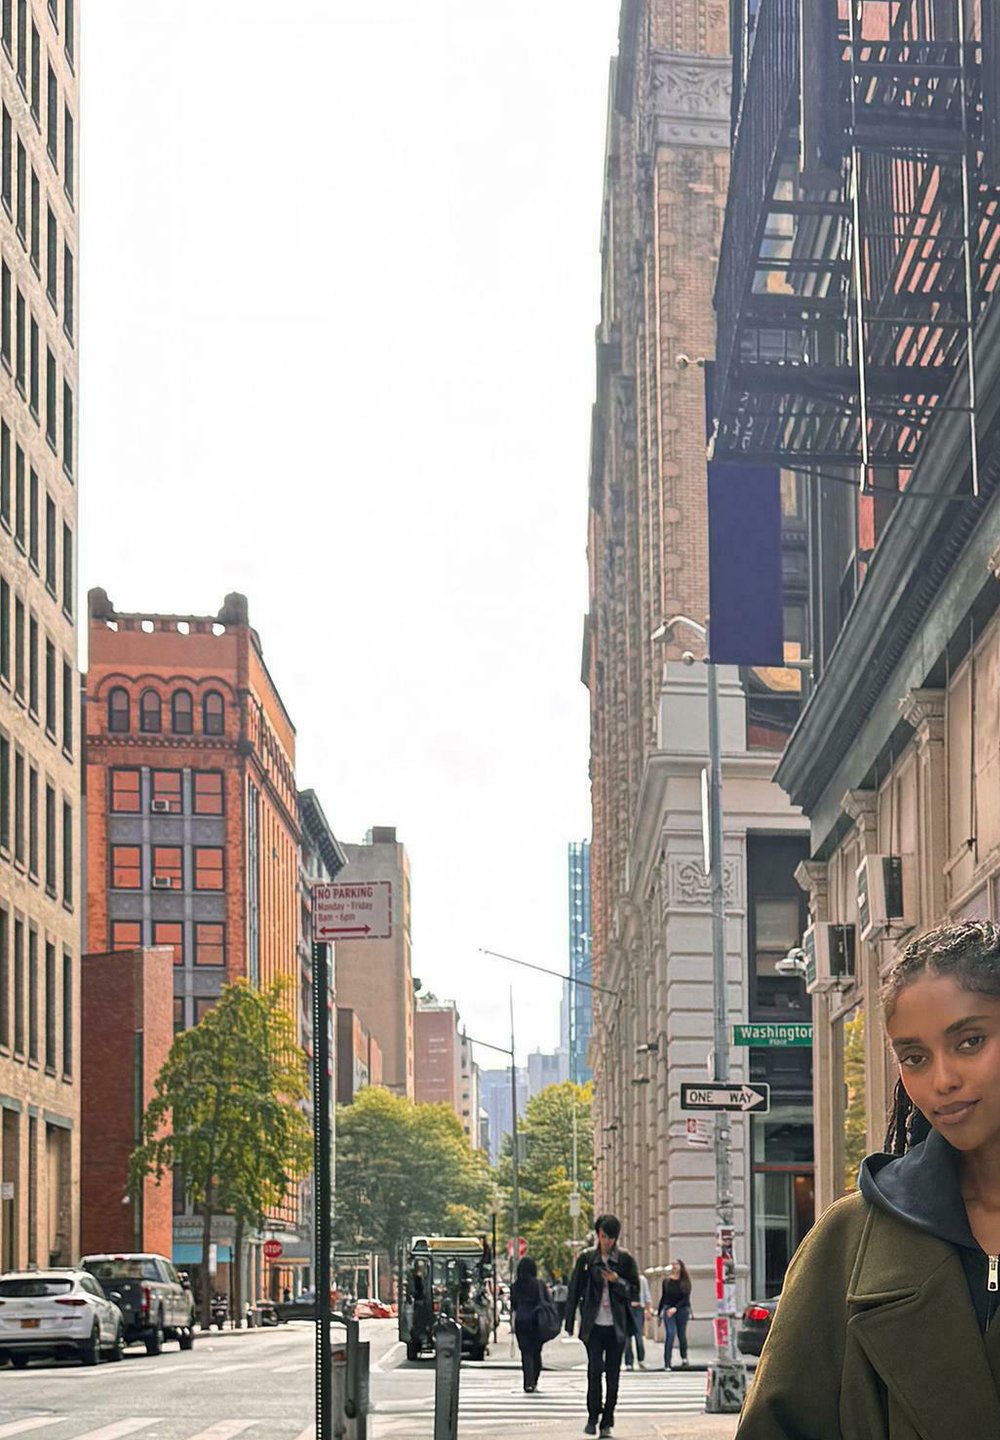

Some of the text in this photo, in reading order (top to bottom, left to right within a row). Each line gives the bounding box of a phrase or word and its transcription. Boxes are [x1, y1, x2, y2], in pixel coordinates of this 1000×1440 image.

[318, 887, 373, 899] NO PARKING
[318, 902, 344, 911] Monday
[351, 901, 372, 911] Friday
[690, 1091, 753, 1103] ONE WAY
[264, 1244, 282, 1253] STOP
